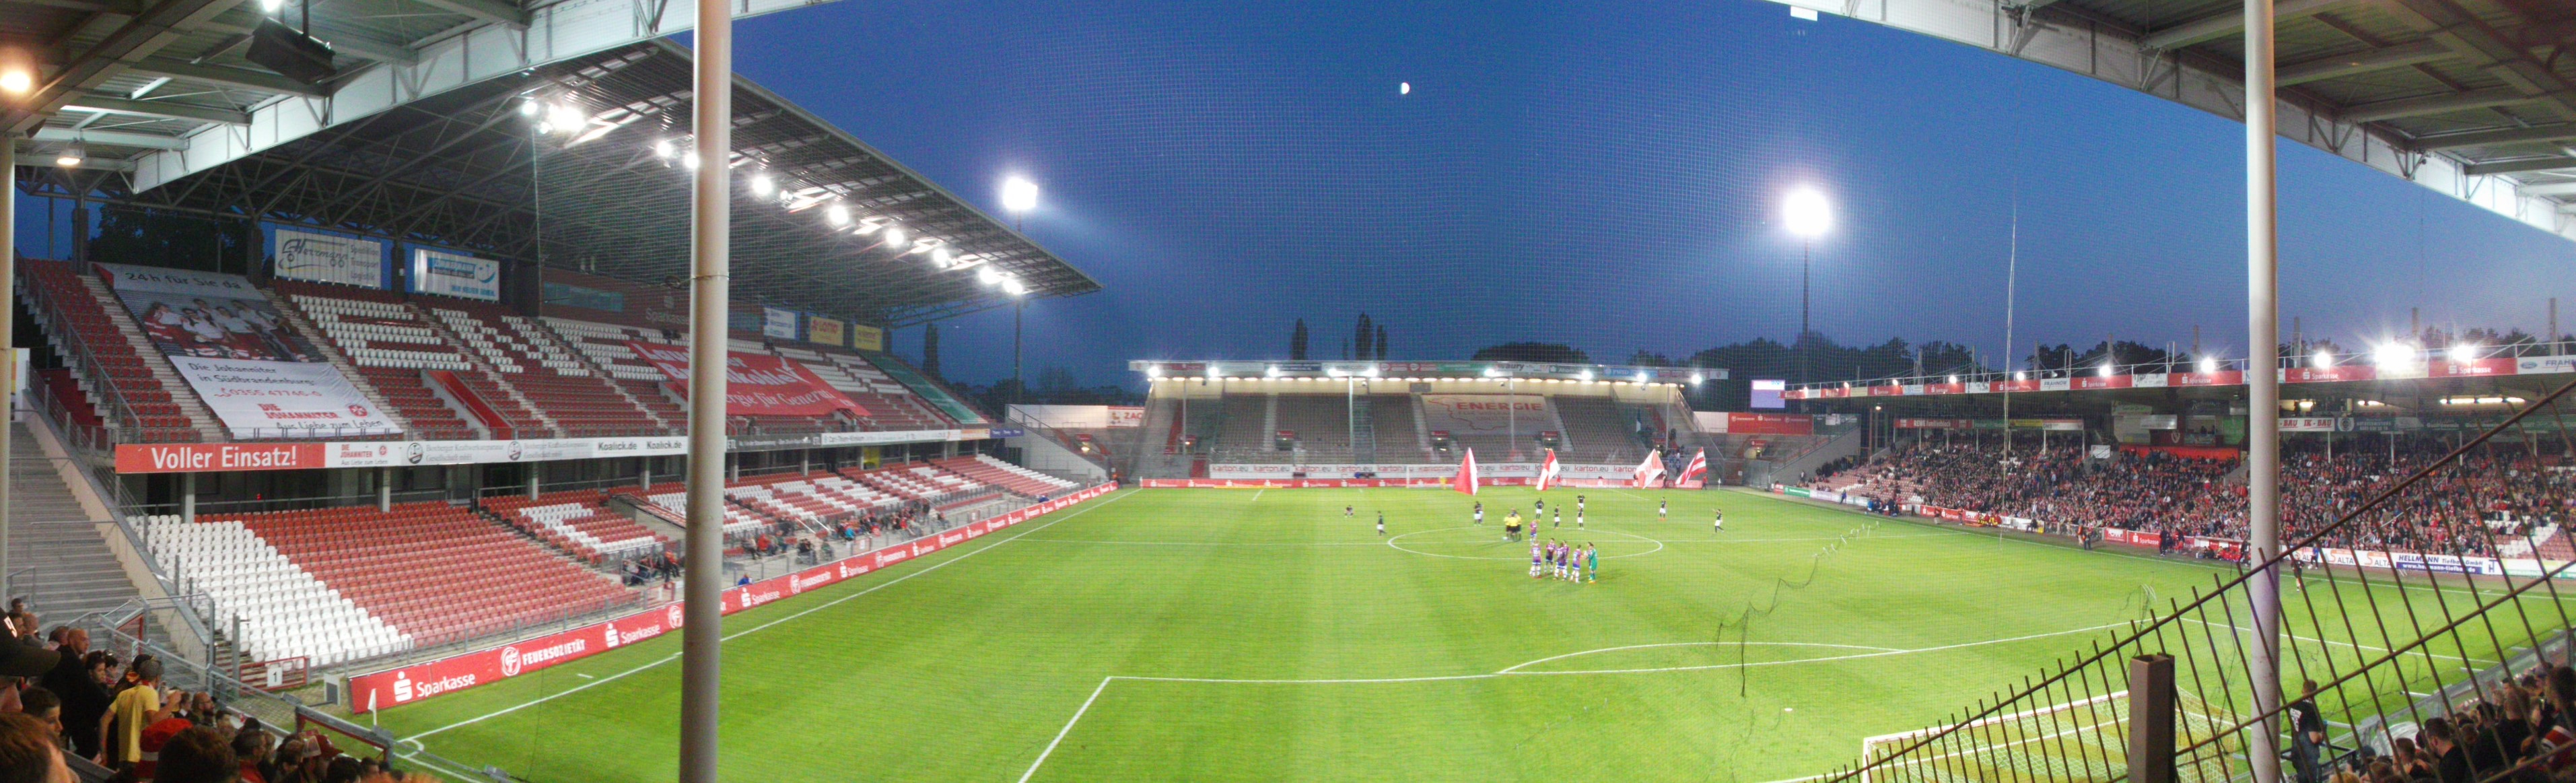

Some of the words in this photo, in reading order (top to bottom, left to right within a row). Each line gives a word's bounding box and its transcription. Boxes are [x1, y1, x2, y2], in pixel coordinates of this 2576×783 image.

[165, 275, 188, 285] für
[193, 277, 218, 287] Sie
[222, 279, 242, 290] da
[188, 362, 209, 371] Die
[214, 364, 277, 374] Johanniter
[2459, 365, 2491, 374] Sparkasse
[755, 392, 777, 408] für
[257, 403, 281, 411] DIE
[1457, 402, 1543, 411] ENERGIE
[276, 421, 298, 430] Aus
[352, 419, 384, 428] Leben
[598, 441, 637, 451] Koalick.de
[647, 440, 683, 450] Koalick.de
[151, 446, 213, 469] Voller
[221, 446, 298, 468] Einsatz!
[1574, 465, 1609, 473] karton.eu
[751, 590, 781, 606] Sparkasse
[621, 623, 661, 644] Sparkasse
[522, 638, 586, 666] FEUERSOZIETÄT
[273, 672, 277, 683] 1
[416, 673, 476, 696] Sparkasse
